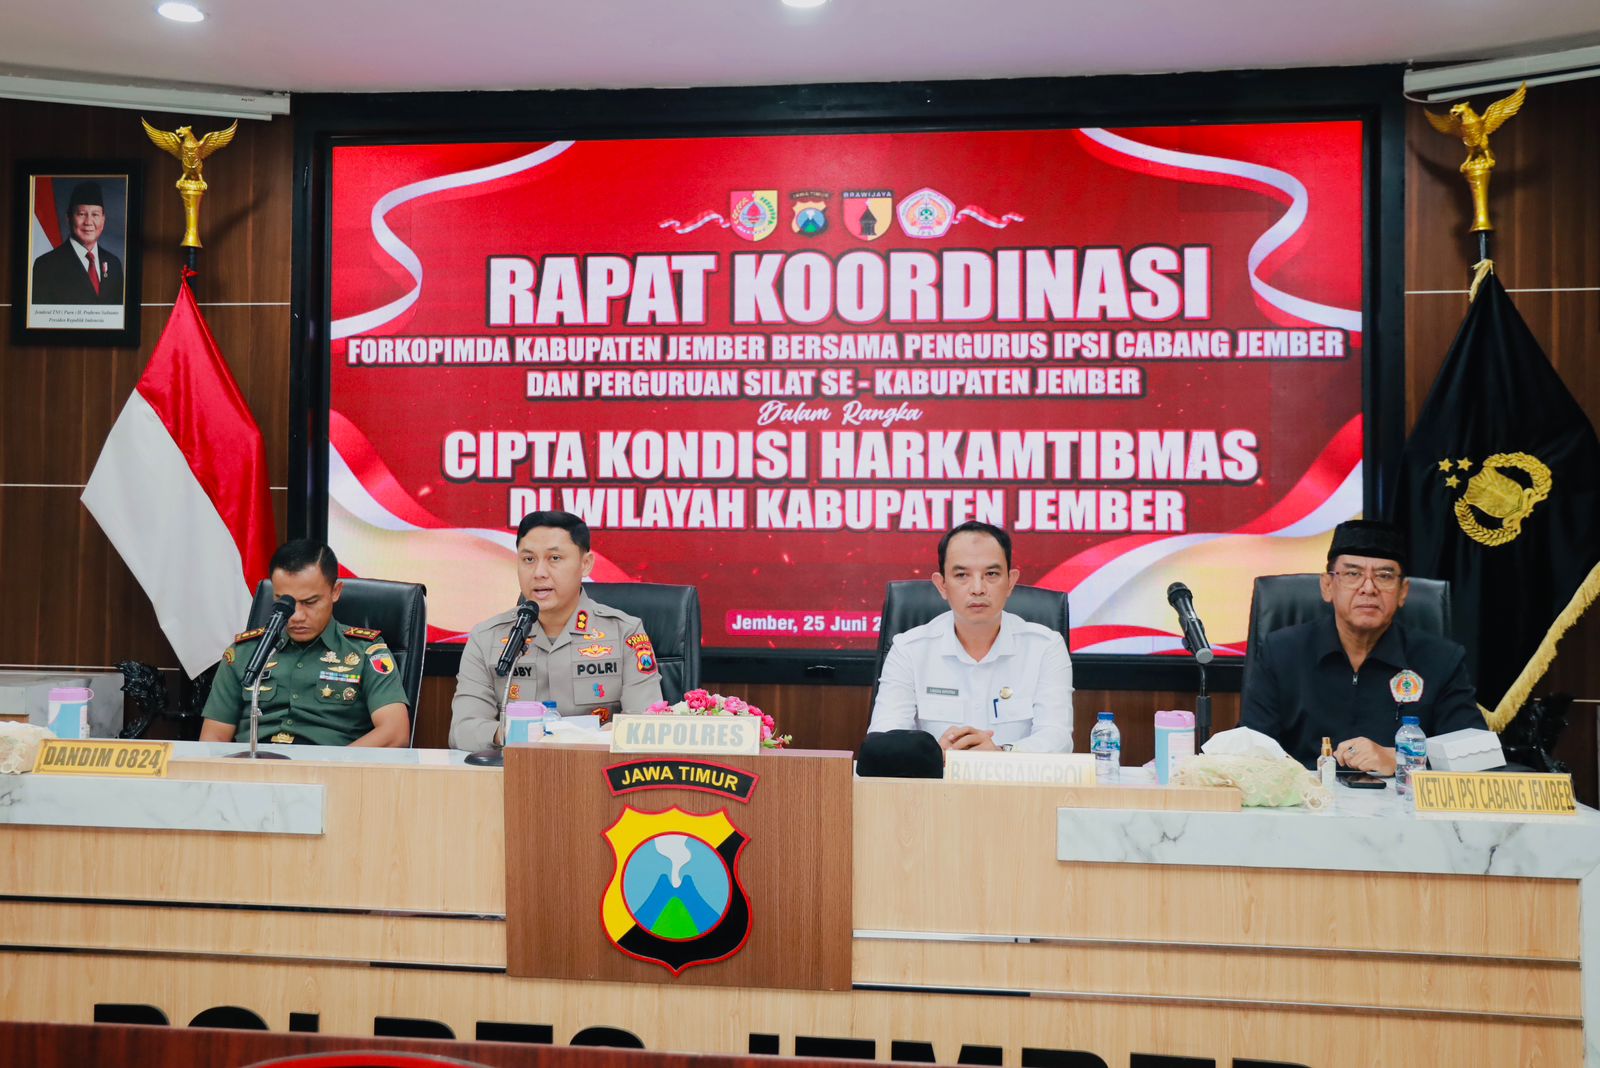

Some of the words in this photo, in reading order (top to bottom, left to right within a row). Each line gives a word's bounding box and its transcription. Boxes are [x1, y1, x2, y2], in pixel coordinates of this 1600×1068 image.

[490, 255, 715, 324] RAPAT
[734, 247, 1207, 323] KOORDINASI
[349, 338, 510, 363] FORKOPIMDA
[515, 337, 661, 362] KABUPATEN
[667, 335, 765, 361] JEMBER
[772, 334, 899, 360] BERSAMA
[905, 333, 1047, 359] PENGURUS
[1054, 332, 1109, 358] IPSI
[1116, 331, 1229, 358] CABANG
[1236, 331, 1343, 357] JEMBER
[527, 372, 578, 397] DAN
[585, 371, 738, 396] PERGURUAN
[744, 370, 816, 396] SILAT
[875, 369, 1029, 395] KABUPATEN
[1035, 369, 1140, 394] JEMBER
[757, 400, 831, 426] Dalam
[842, 400, 923, 428] Rangka
[445, 431, 586, 478] CIPTA
[599, 430, 806, 479] KONDISI
[821, 430, 1258, 480] HARKAMTIBMAS
[509, 488, 551, 527] DI
[562, 488, 744, 528] WILAYAH
[756, 489, 1003, 530] KABUPATEN
[1014, 490, 1183, 531] JEMBER
[732, 615, 798, 633] Jember,
[803, 615, 825, 631] 25
[830, 616, 867, 632] Juni
[577, 662, 617, 675] POLRI
[626, 722, 743, 747] KAPOLRES
[43, 746, 113, 767] DANDIM
[115, 748, 161, 769] 0824
[621, 766, 674, 785] JAWA
[678, 766, 739, 791] TIMUR
[1418, 777, 1456, 808] KETUA
[1455, 778, 1477, 809] IPSI
[1479, 779, 1526, 810] CABANG
[1528, 780, 1574, 811] JEMBER
